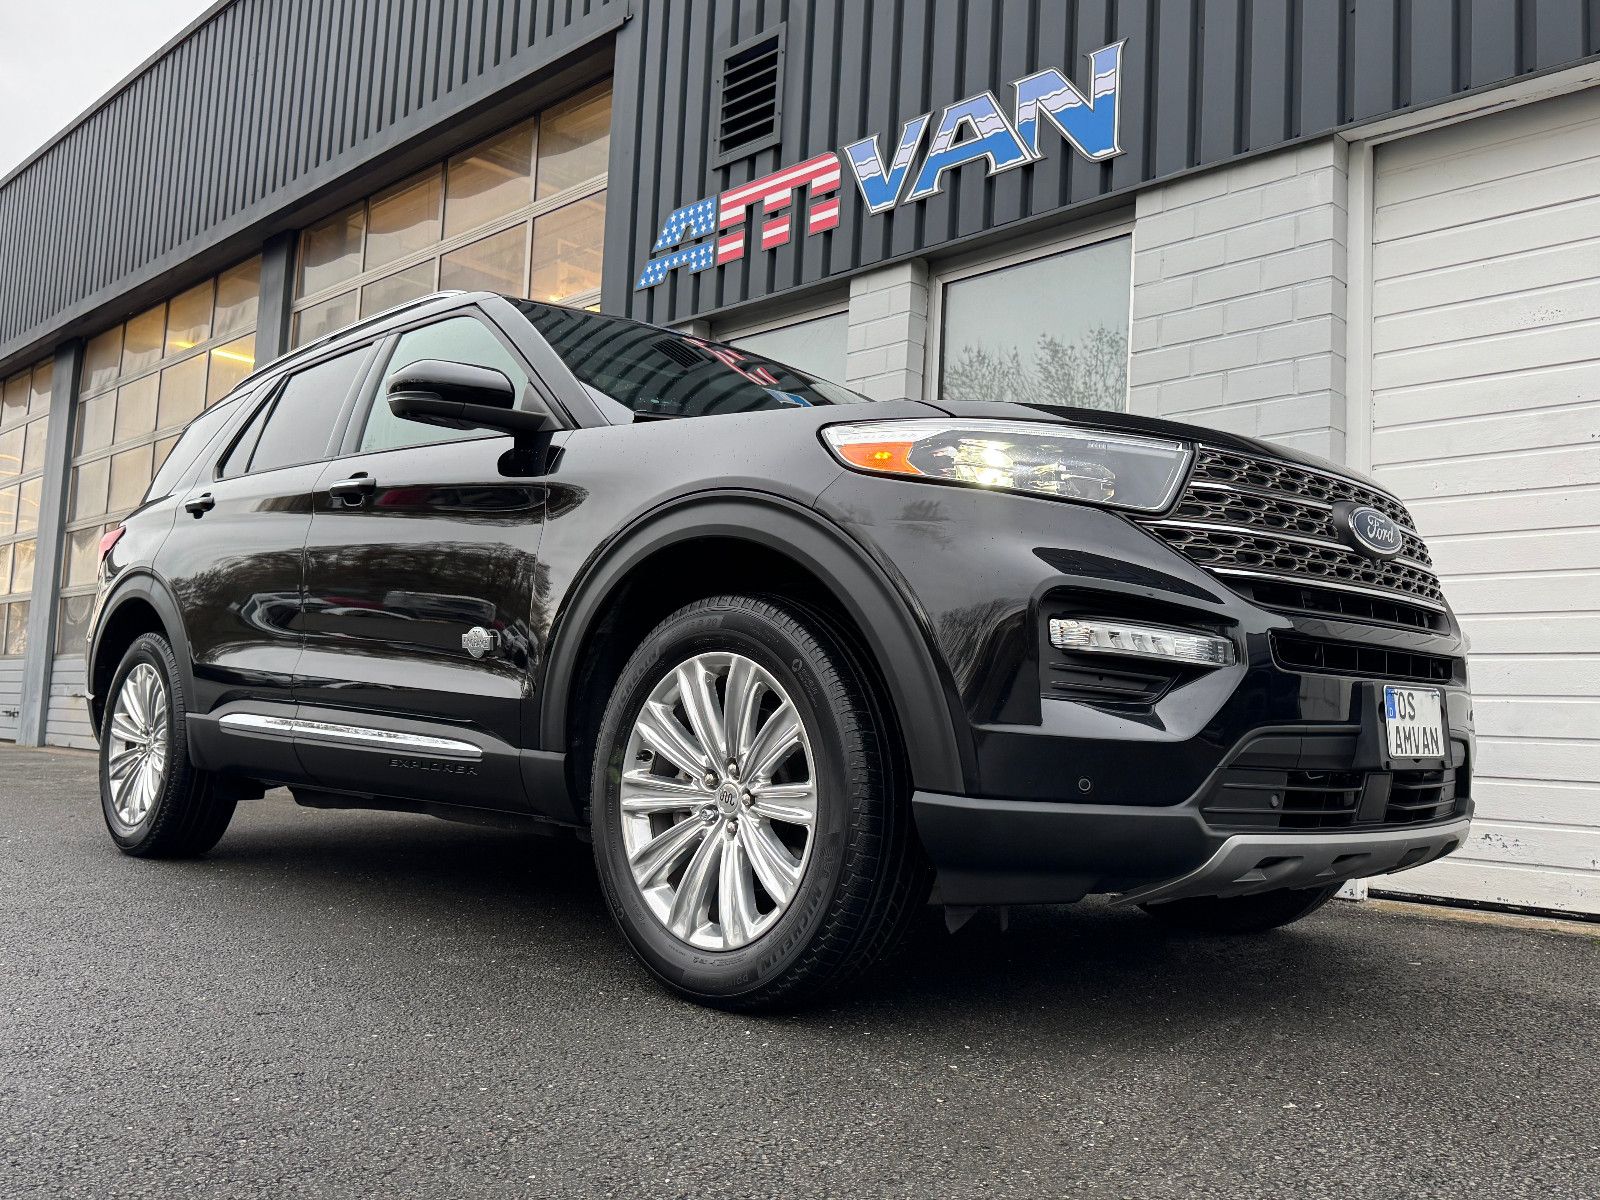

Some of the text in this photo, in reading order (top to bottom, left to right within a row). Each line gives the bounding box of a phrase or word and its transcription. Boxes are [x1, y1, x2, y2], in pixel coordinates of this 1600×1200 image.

[1367, 515, 1395, 543] Ford
[1398, 692, 1416, 721] OS
[1395, 725, 1440, 755] AMVAN
[389, 759, 479, 776] EXPLORER
[762, 885, 823, 971] MICHELIN
